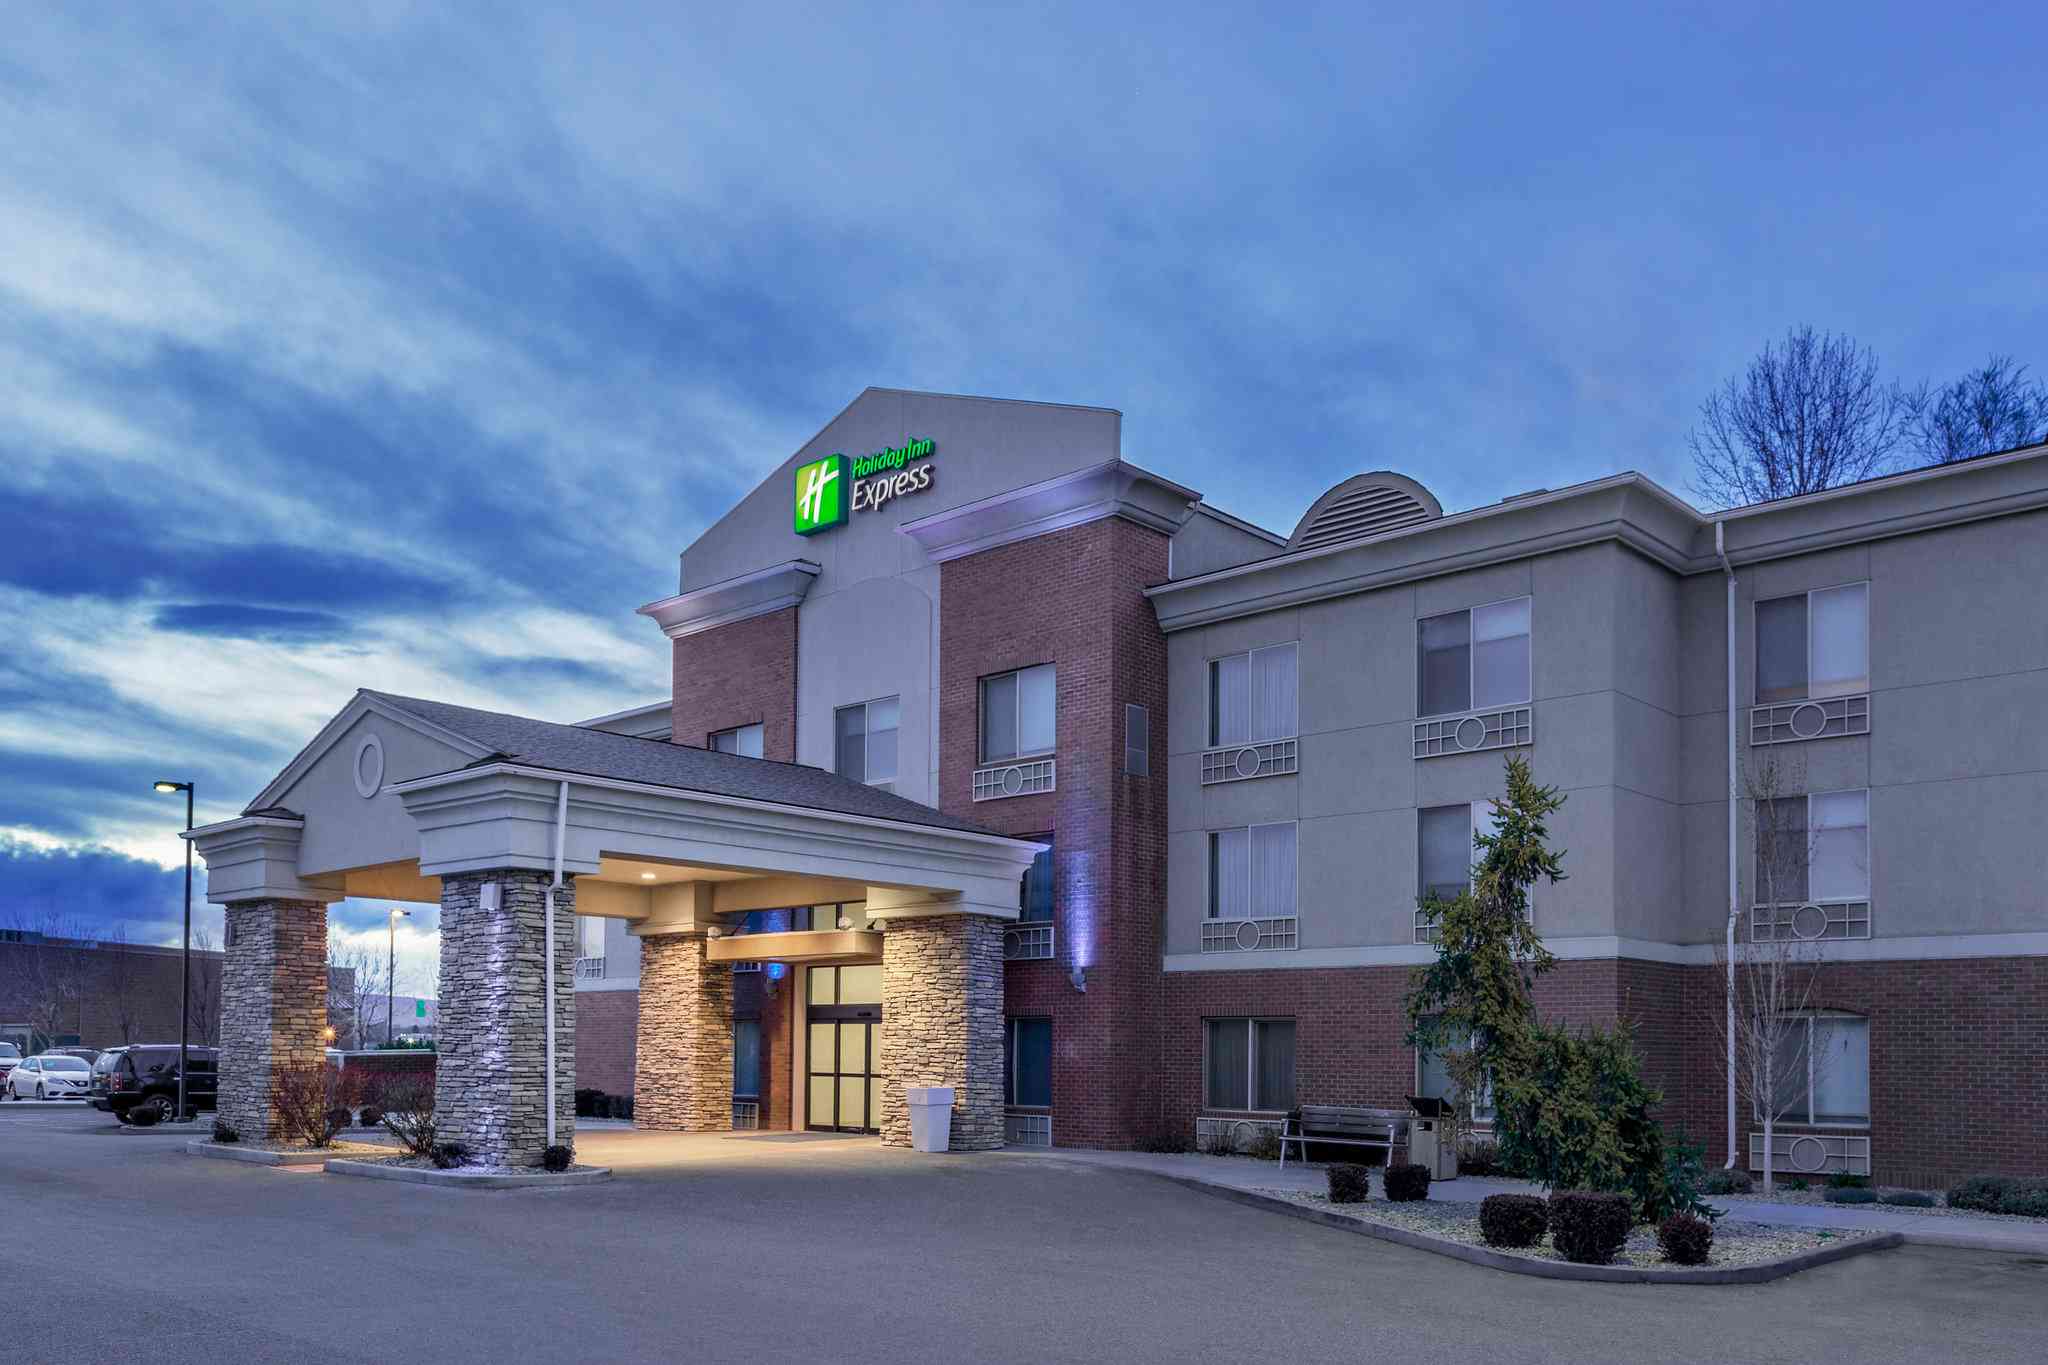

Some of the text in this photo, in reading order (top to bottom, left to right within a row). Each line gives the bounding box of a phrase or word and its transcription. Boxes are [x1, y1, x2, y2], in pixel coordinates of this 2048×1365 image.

[852, 437, 932, 478] Holiday Inn
[851, 463, 931, 511] Express
